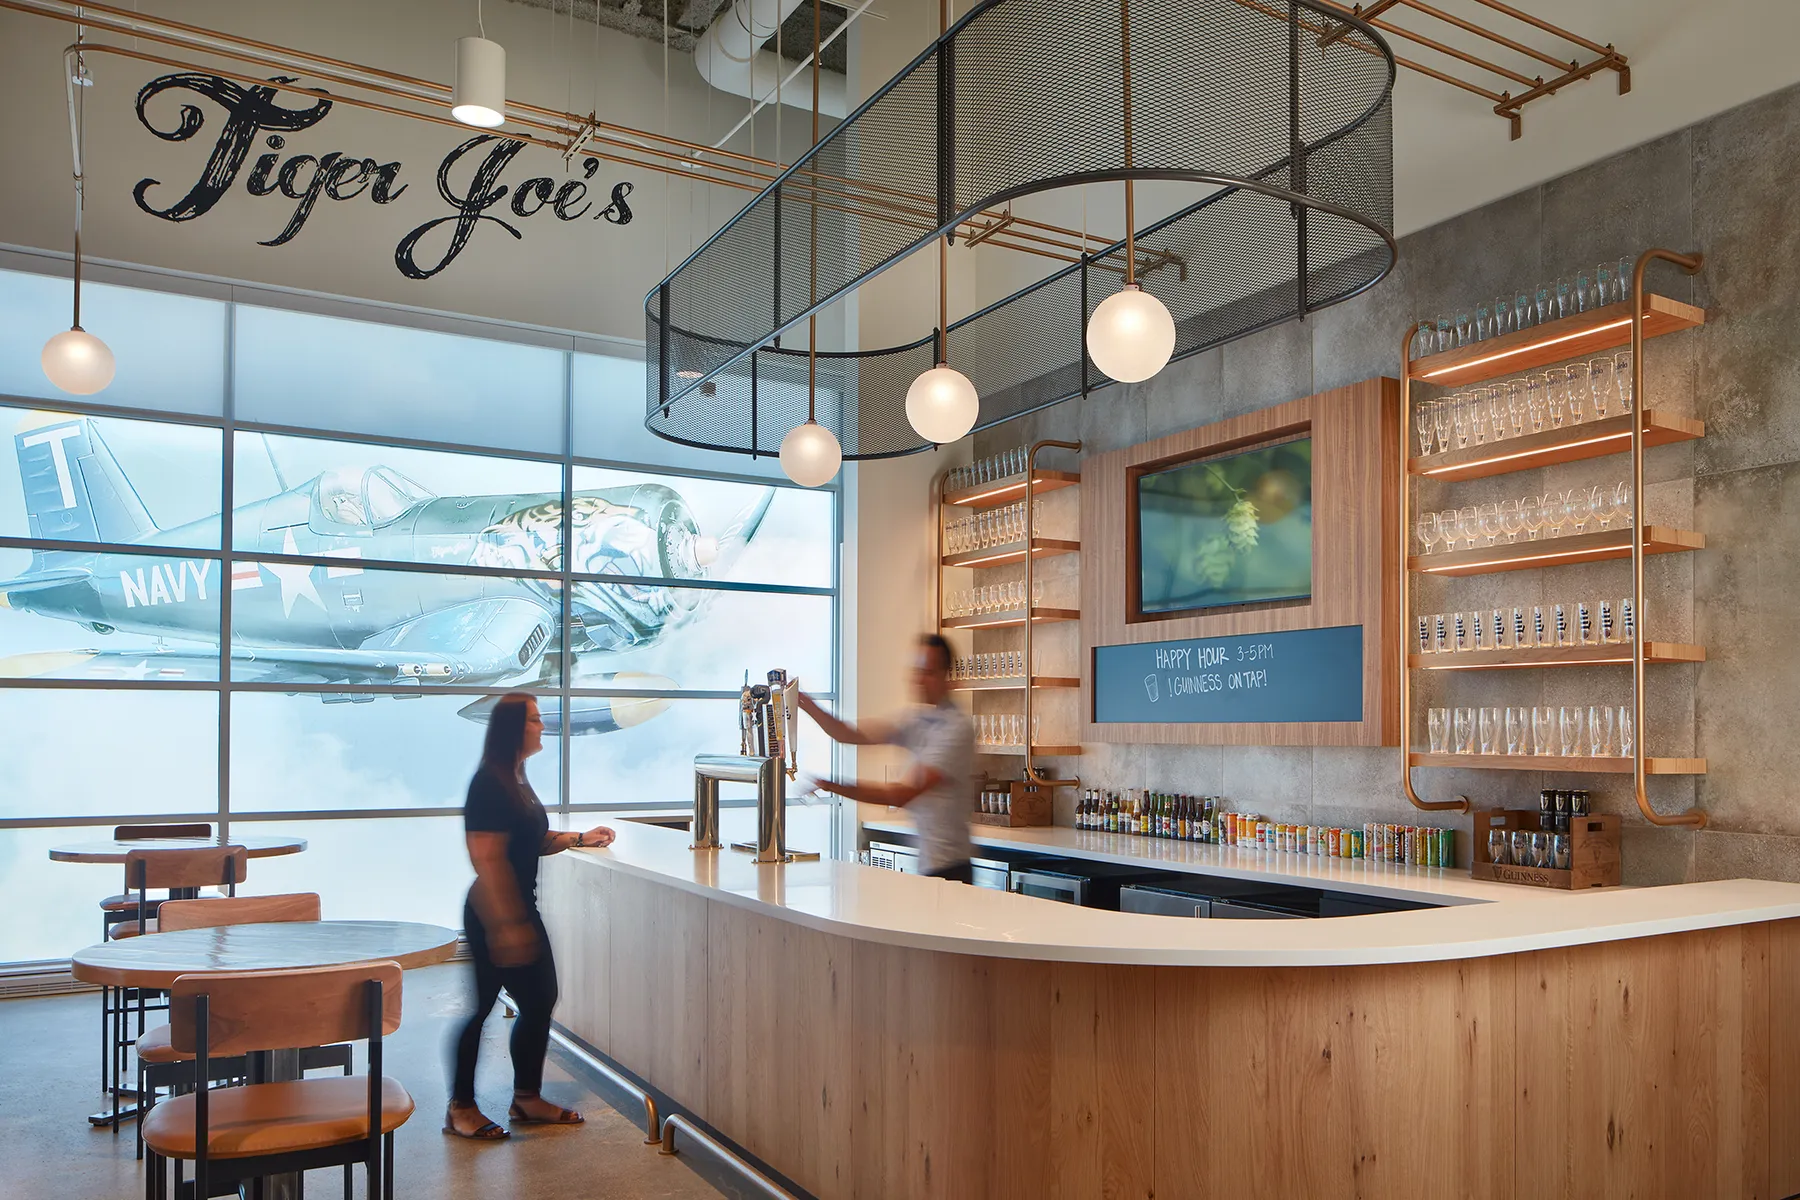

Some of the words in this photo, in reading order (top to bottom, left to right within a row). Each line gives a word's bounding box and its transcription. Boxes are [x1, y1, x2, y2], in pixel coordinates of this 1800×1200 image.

[132, 72, 409, 247] Tiger
[394, 133, 635, 280] Joe's
[23, 425, 81, 509] T
[120, 558, 212, 609] NAVY
[1156, 648, 1192, 670] HAPPY
[1197, 646, 1230, 669] HOUR
[1502, 869, 1550, 883] GUINNESS
